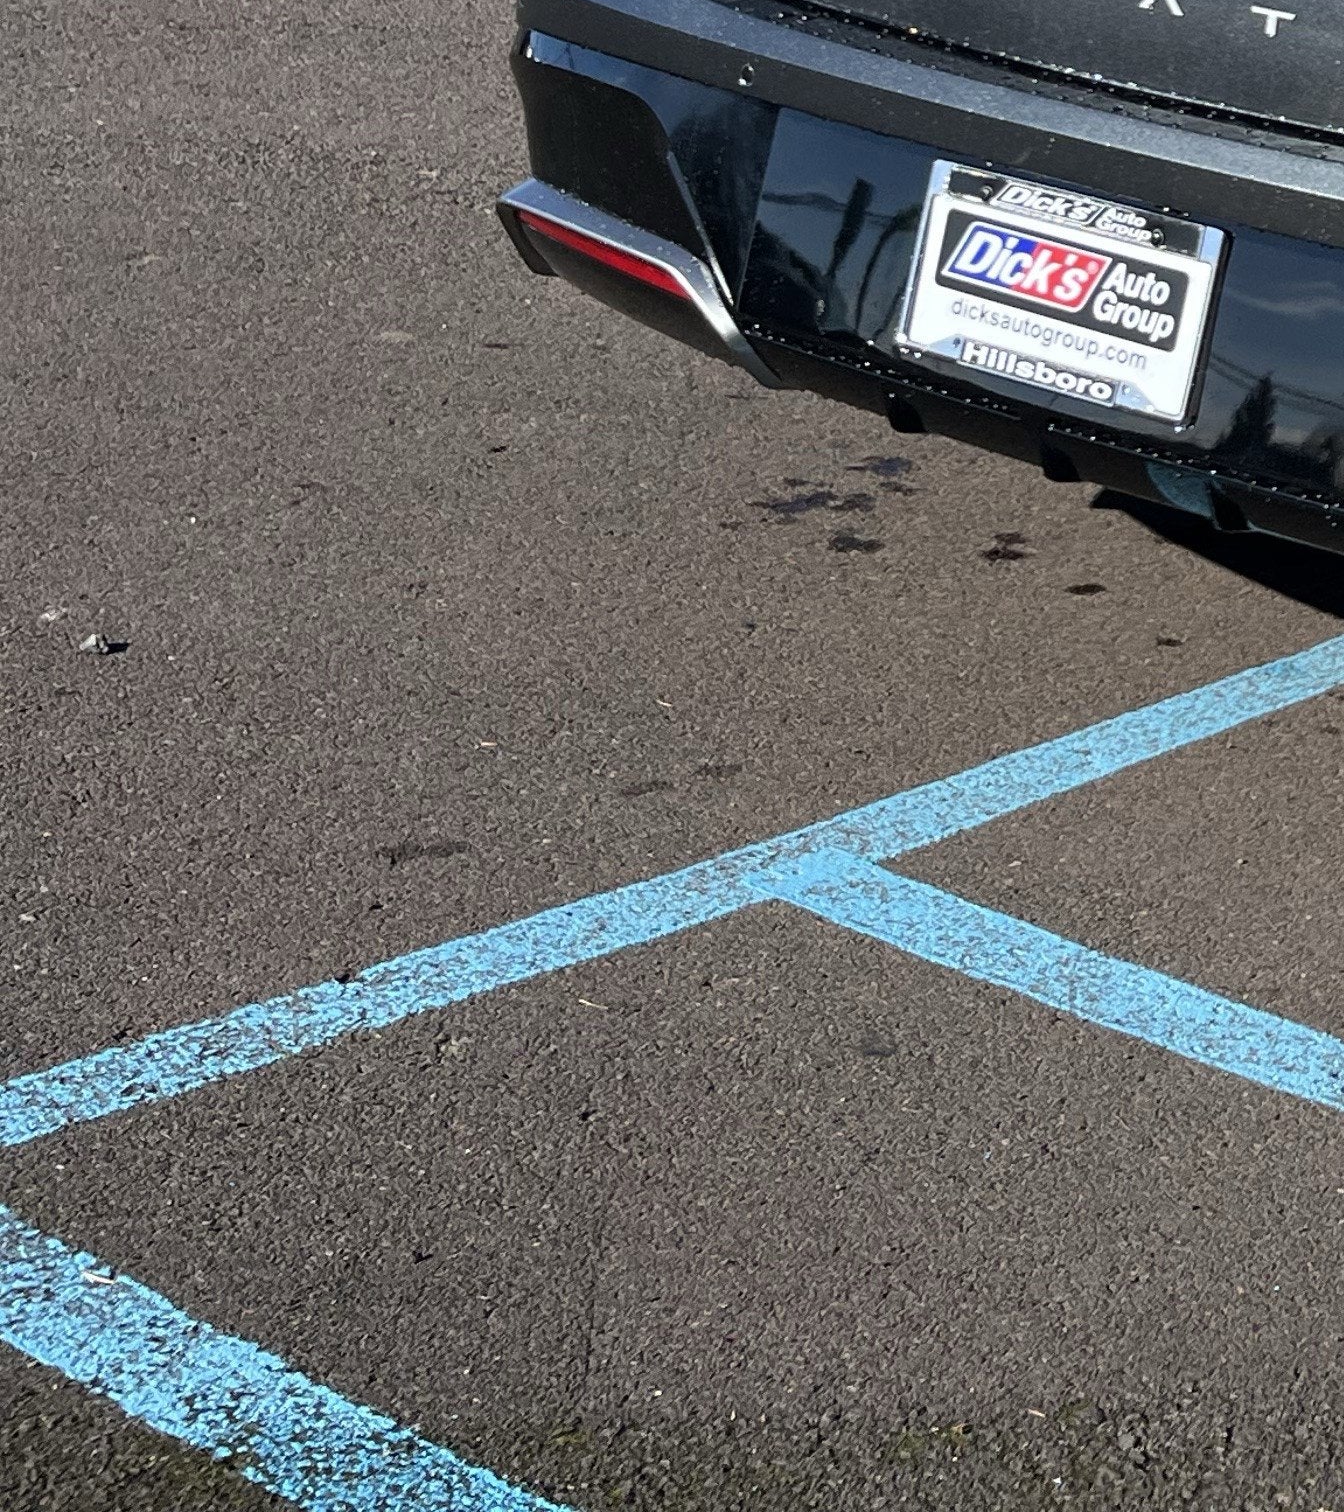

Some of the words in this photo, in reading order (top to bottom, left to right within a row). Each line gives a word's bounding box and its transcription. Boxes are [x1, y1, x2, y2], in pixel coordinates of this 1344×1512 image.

[1001, 186, 1098, 220] Dick's
[1104, 207, 1147, 228] Auto
[954, 231, 1091, 302] Dick's
[1102, 262, 1170, 305] Auto
[952, 297, 1147, 370] dicksautogroup.com
[1092, 289, 1175, 343] Group
[960, 341, 1113, 401] Hillsboro
